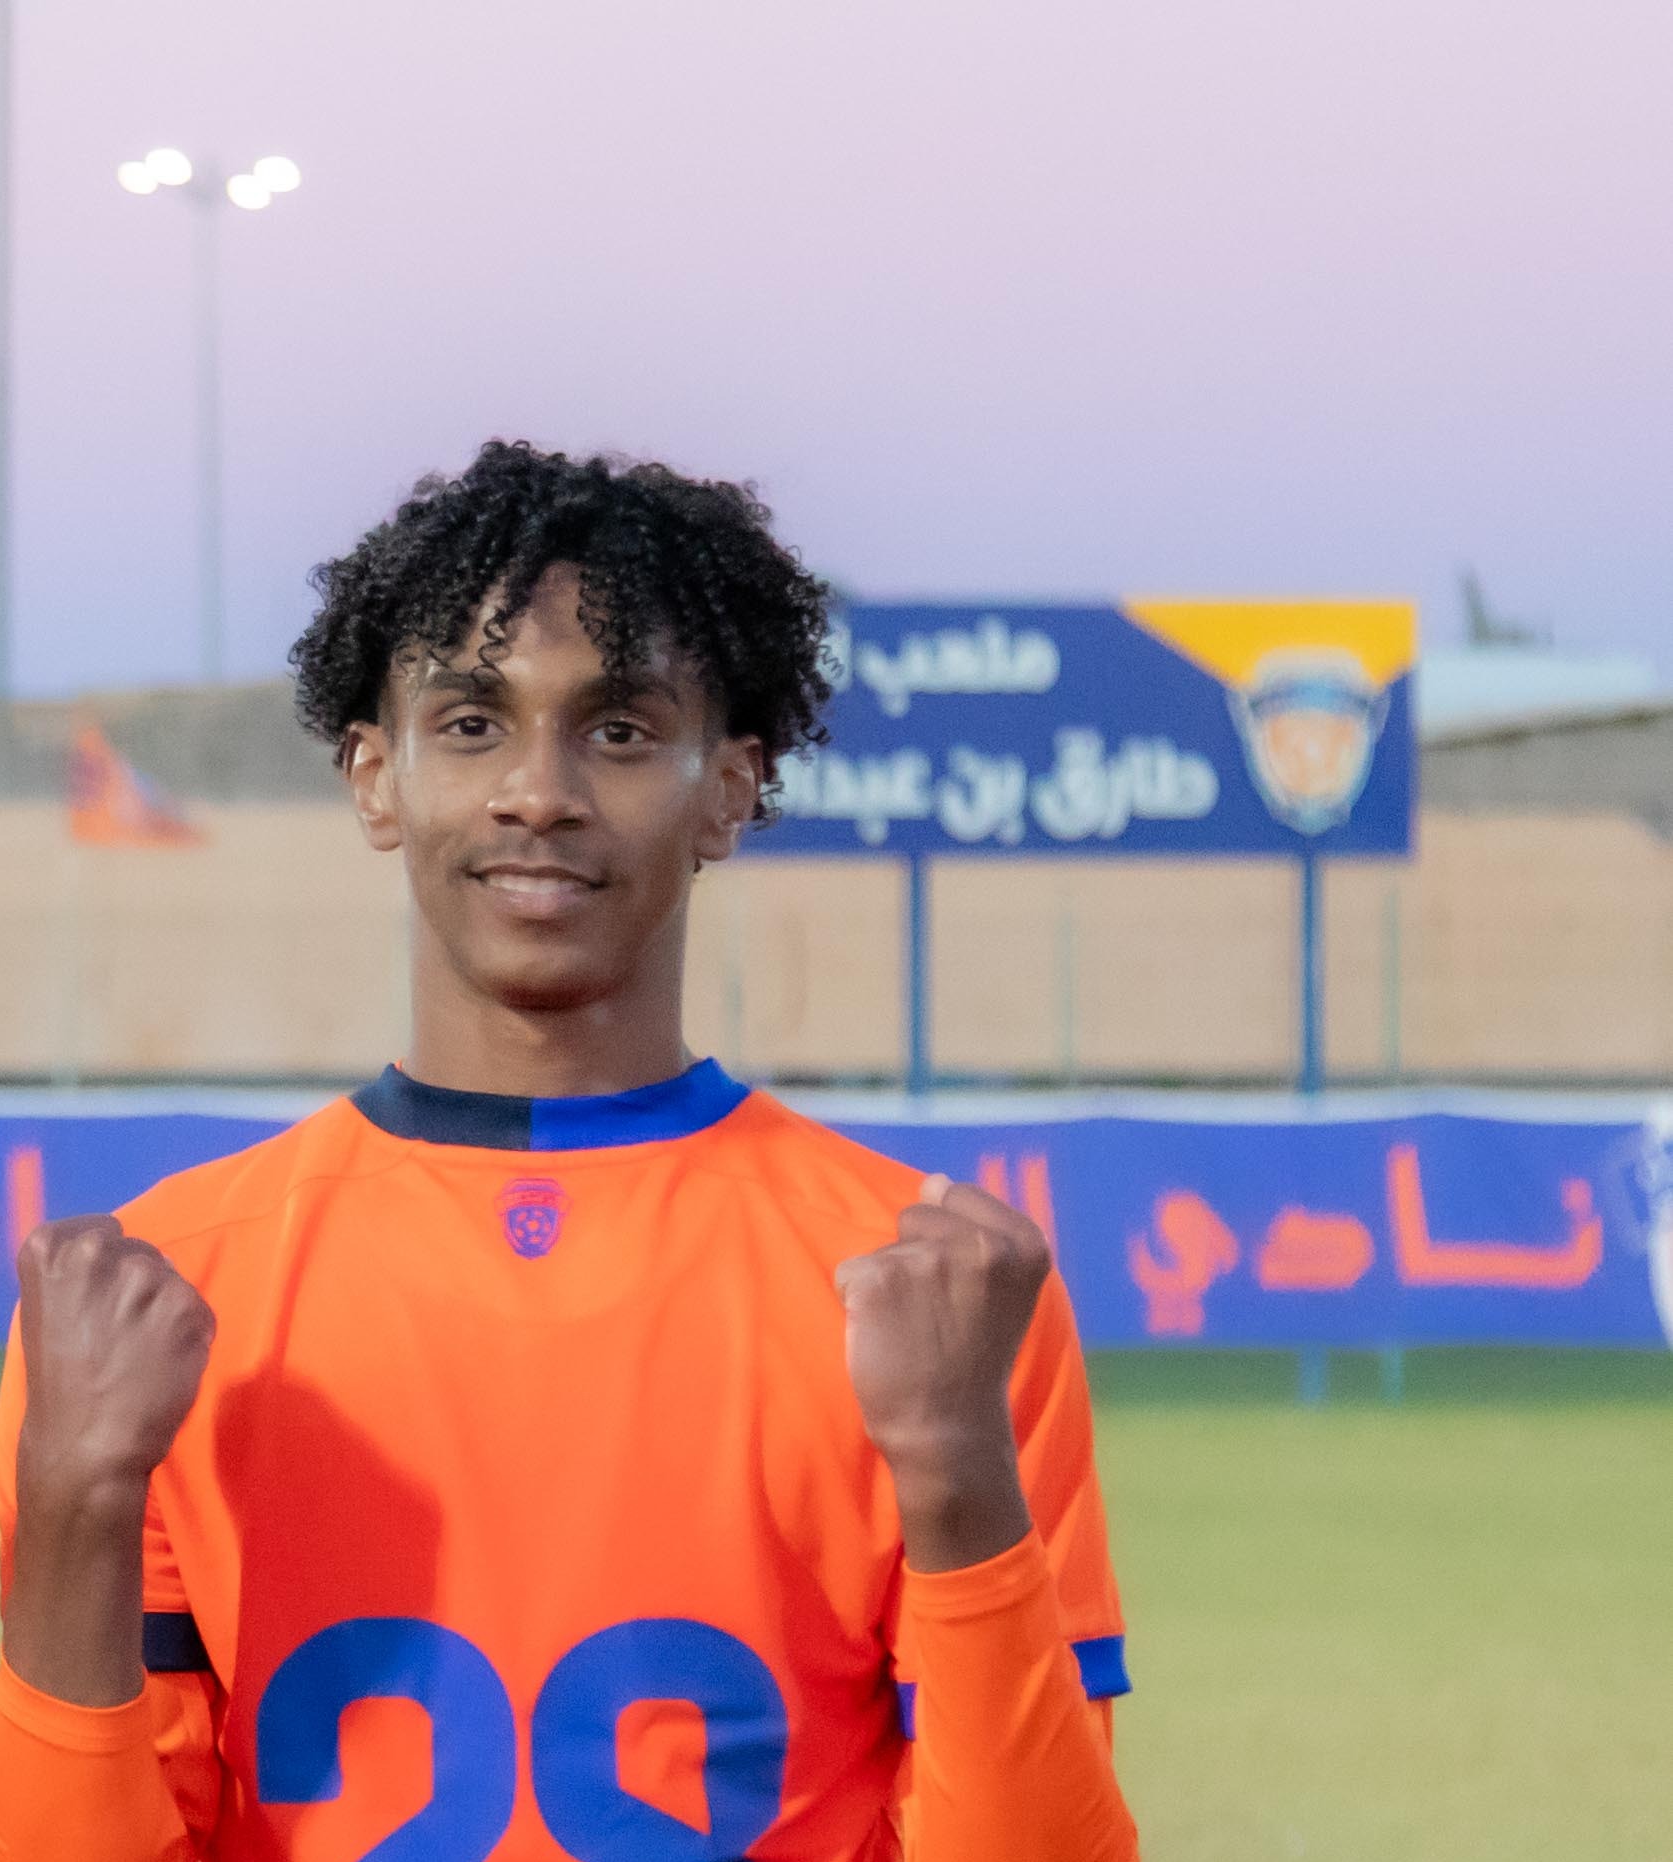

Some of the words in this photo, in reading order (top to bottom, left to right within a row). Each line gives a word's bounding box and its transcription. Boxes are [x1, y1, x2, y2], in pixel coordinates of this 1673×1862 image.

[857, 616, 1058, 715] ملعب
[938, 745, 1026, 845] بن
[1030, 731, 1218, 838] طارق
